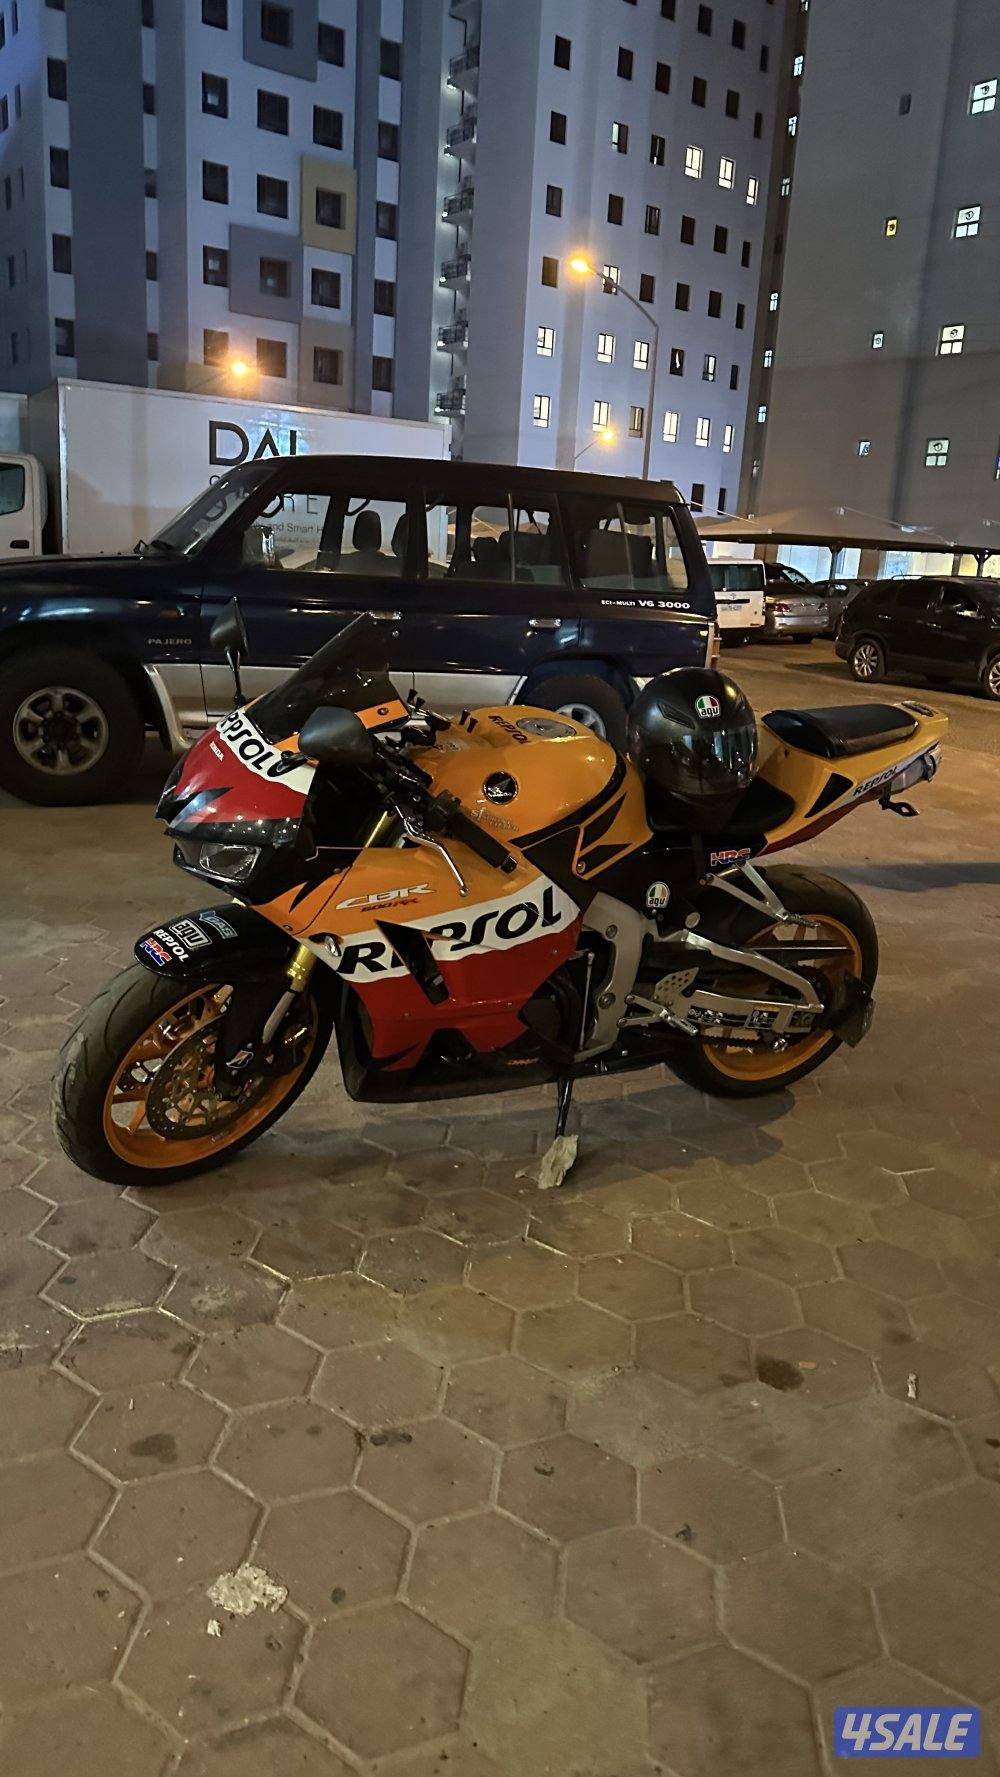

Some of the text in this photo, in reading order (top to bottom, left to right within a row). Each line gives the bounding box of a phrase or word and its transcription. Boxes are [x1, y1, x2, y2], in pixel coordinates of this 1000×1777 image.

[287, 522, 313, 533] Smart
[638, 599, 654, 607] V6
[658, 601, 690, 609] 3000
[488, 715, 532, 744] REPSOL
[853, 765, 897, 797] REPSOL
[710, 848, 751, 867] HRC
[336, 883, 437, 910] CBR
[336, 886, 562, 975] RPSOL
[140, 937, 172, 967] HRC
[153, 929, 189, 963] REPSOL
